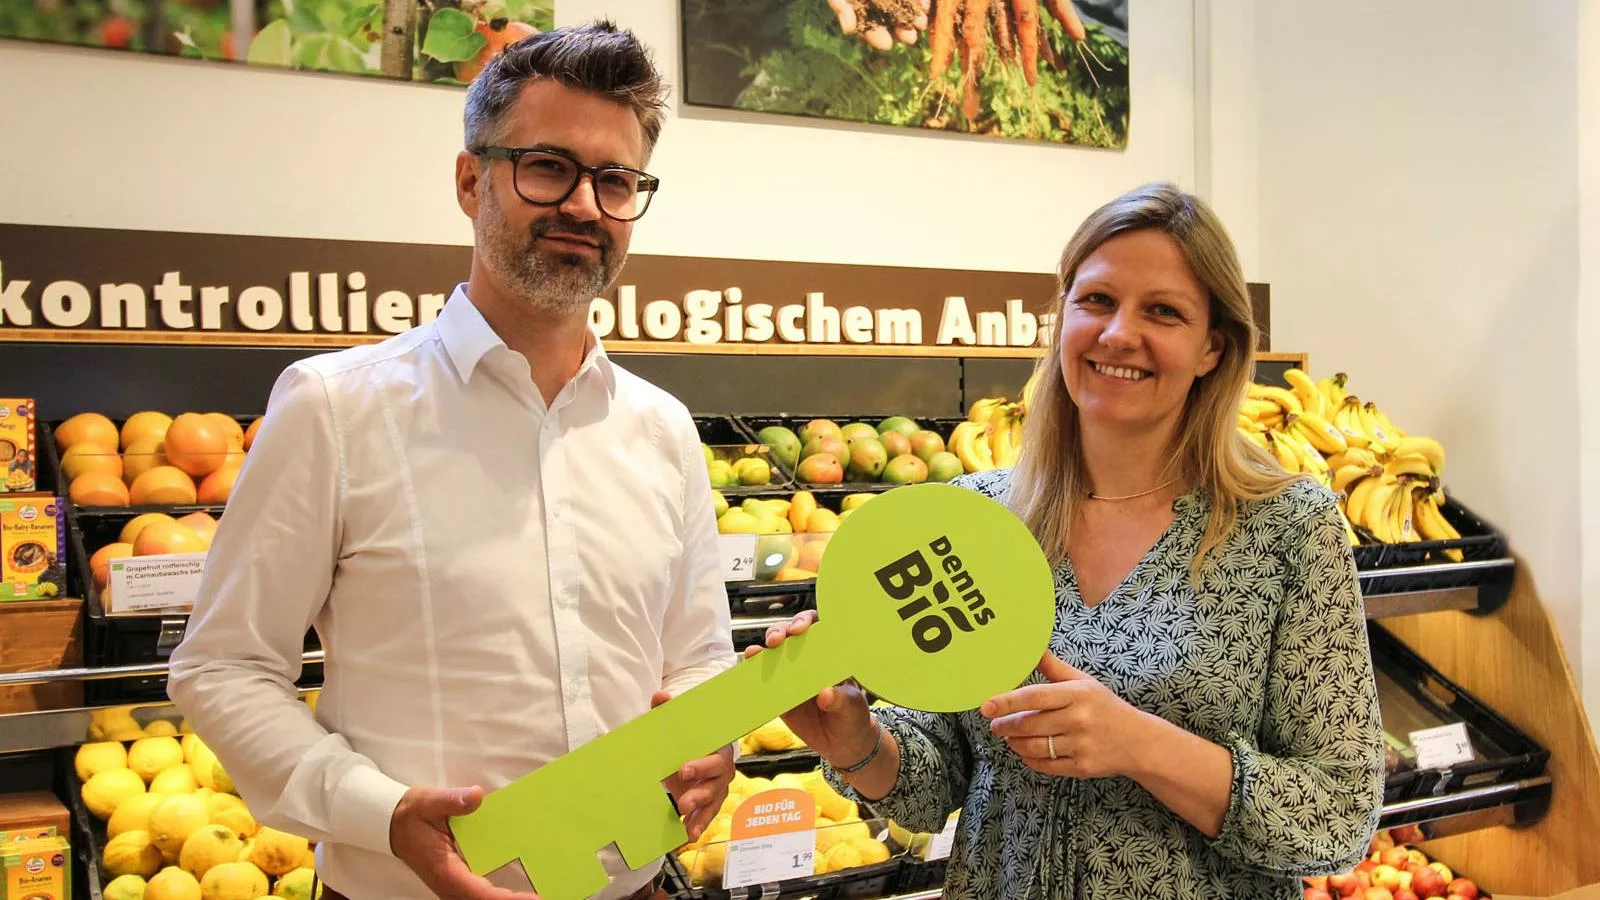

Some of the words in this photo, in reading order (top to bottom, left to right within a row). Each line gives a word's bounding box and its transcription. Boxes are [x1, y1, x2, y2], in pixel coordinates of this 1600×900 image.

[126, 564, 161, 573] Grapefruit
[929, 535, 996, 626] Denns
[753, 803, 774, 815] BIO
[775, 798, 795, 811] FÜR
[745, 814, 780, 828] JEDEN
[781, 810, 801, 822] TAG
[792, 851, 813, 868] 1.99
